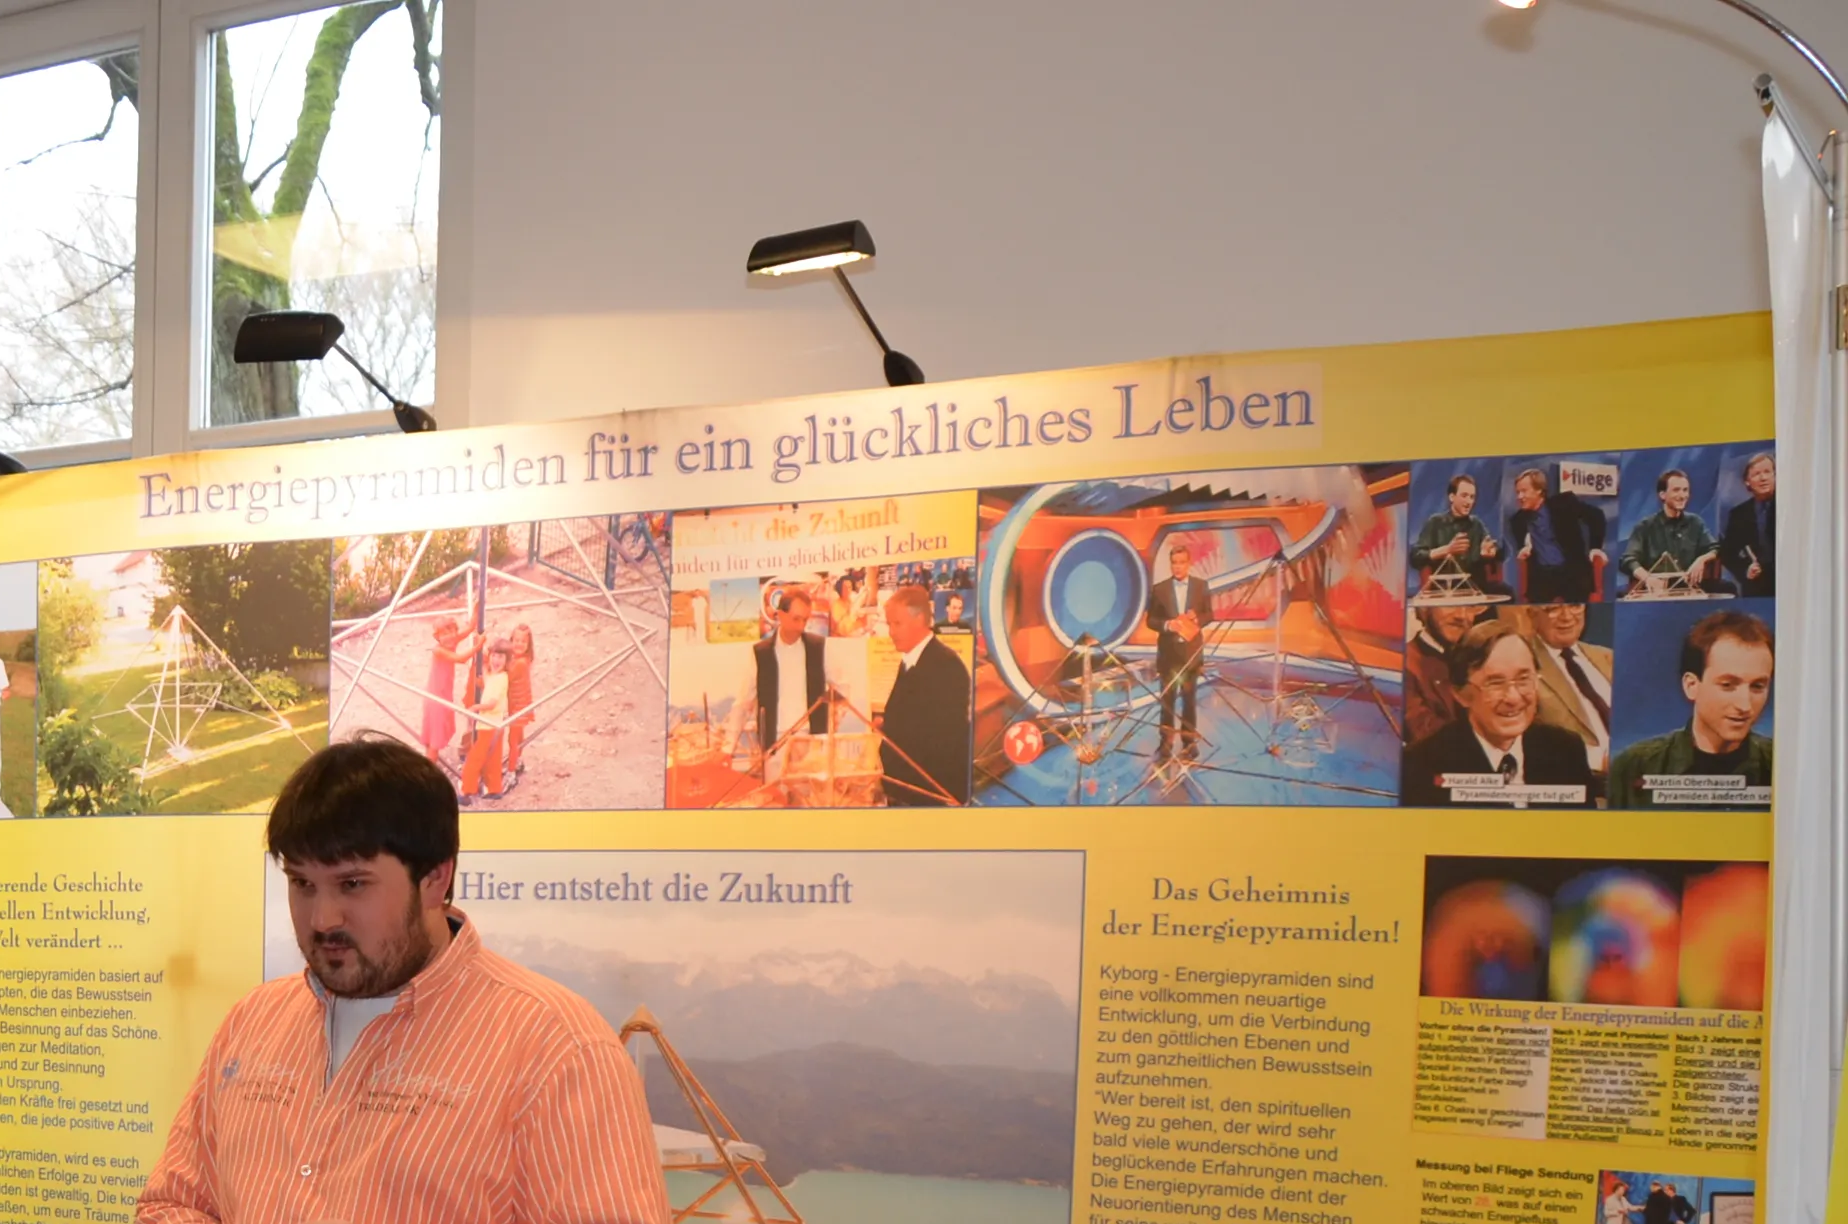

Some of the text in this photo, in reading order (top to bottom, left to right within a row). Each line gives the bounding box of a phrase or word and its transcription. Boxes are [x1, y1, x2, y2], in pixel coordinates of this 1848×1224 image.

[140, 375, 1315, 524] Energiepyramiden für ein glückliches Leben
[1571, 469, 1614, 493] fliege
[1649, 778, 1741, 787] Martin Oberhauser
[52, 871, 143, 893] Geschichte
[458, 871, 854, 905] Hier entsteht die Zukunft
[1152, 875, 1350, 905] Das Geheimnis
[42, 900, 151, 926] Entwicklung,
[25, 927, 101, 949] verändert
[1102, 909, 1399, 946] der Energiepyramiden!
[98, 968, 141, 983] basiert
[143, 969, 164, 984] auf
[1099, 964, 1159, 986] Kyborg
[1175, 966, 1332, 989] Energiepyramiden
[1337, 973, 1374, 990] sind
[29, 985, 48, 1000] die
[50, 987, 73, 1000] das
[76, 986, 153, 1002] Bewusstsein
[1100, 987, 1327, 1013] eine vollkommen neuartige
[1098, 1005, 1371, 1038] Entwicklung, um die Verbindung
[1440, 1000, 1750, 1030] Die Wirkung der Energiepyramiden auf die
[1415, 1159, 1595, 1185] Messung bei Fliege Sendung
